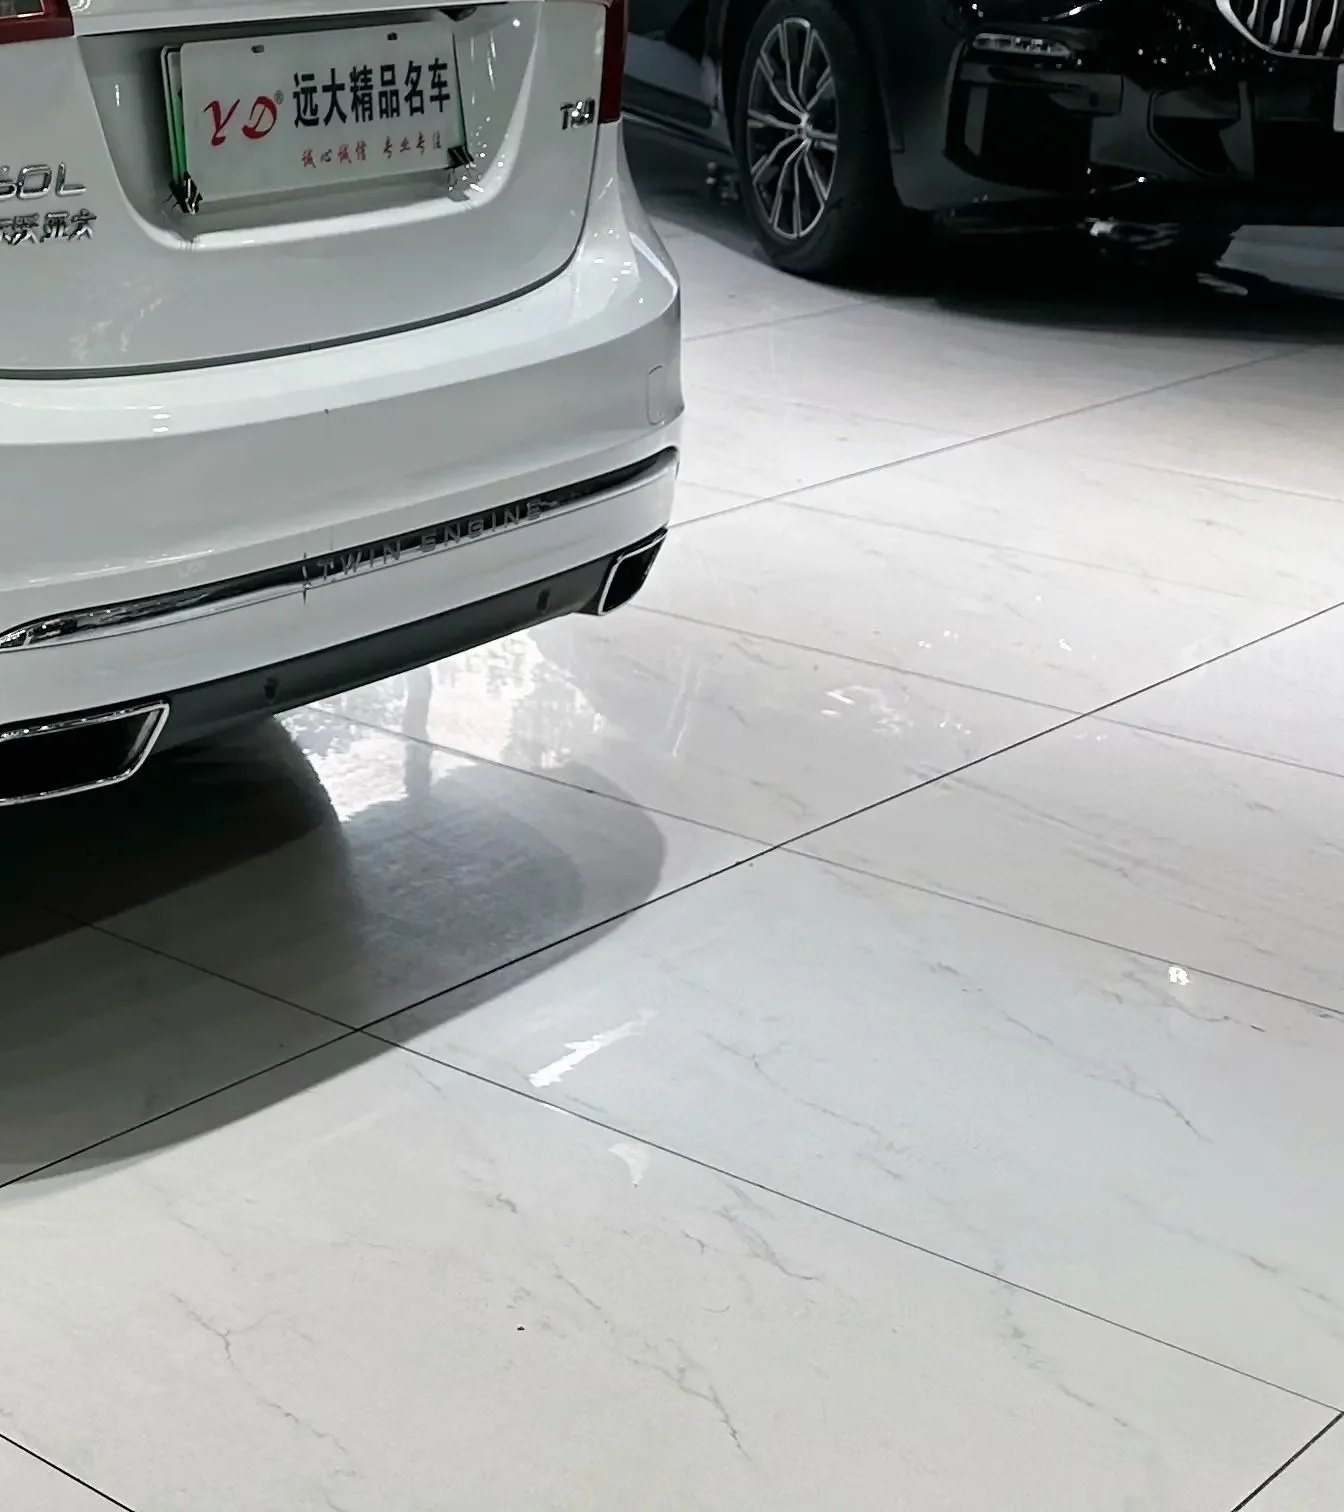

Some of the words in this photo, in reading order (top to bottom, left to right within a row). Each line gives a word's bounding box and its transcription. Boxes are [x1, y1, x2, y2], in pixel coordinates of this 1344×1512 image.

[291, 57, 453, 129] 远大精品名车
[317, 539, 401, 582] TWIN
